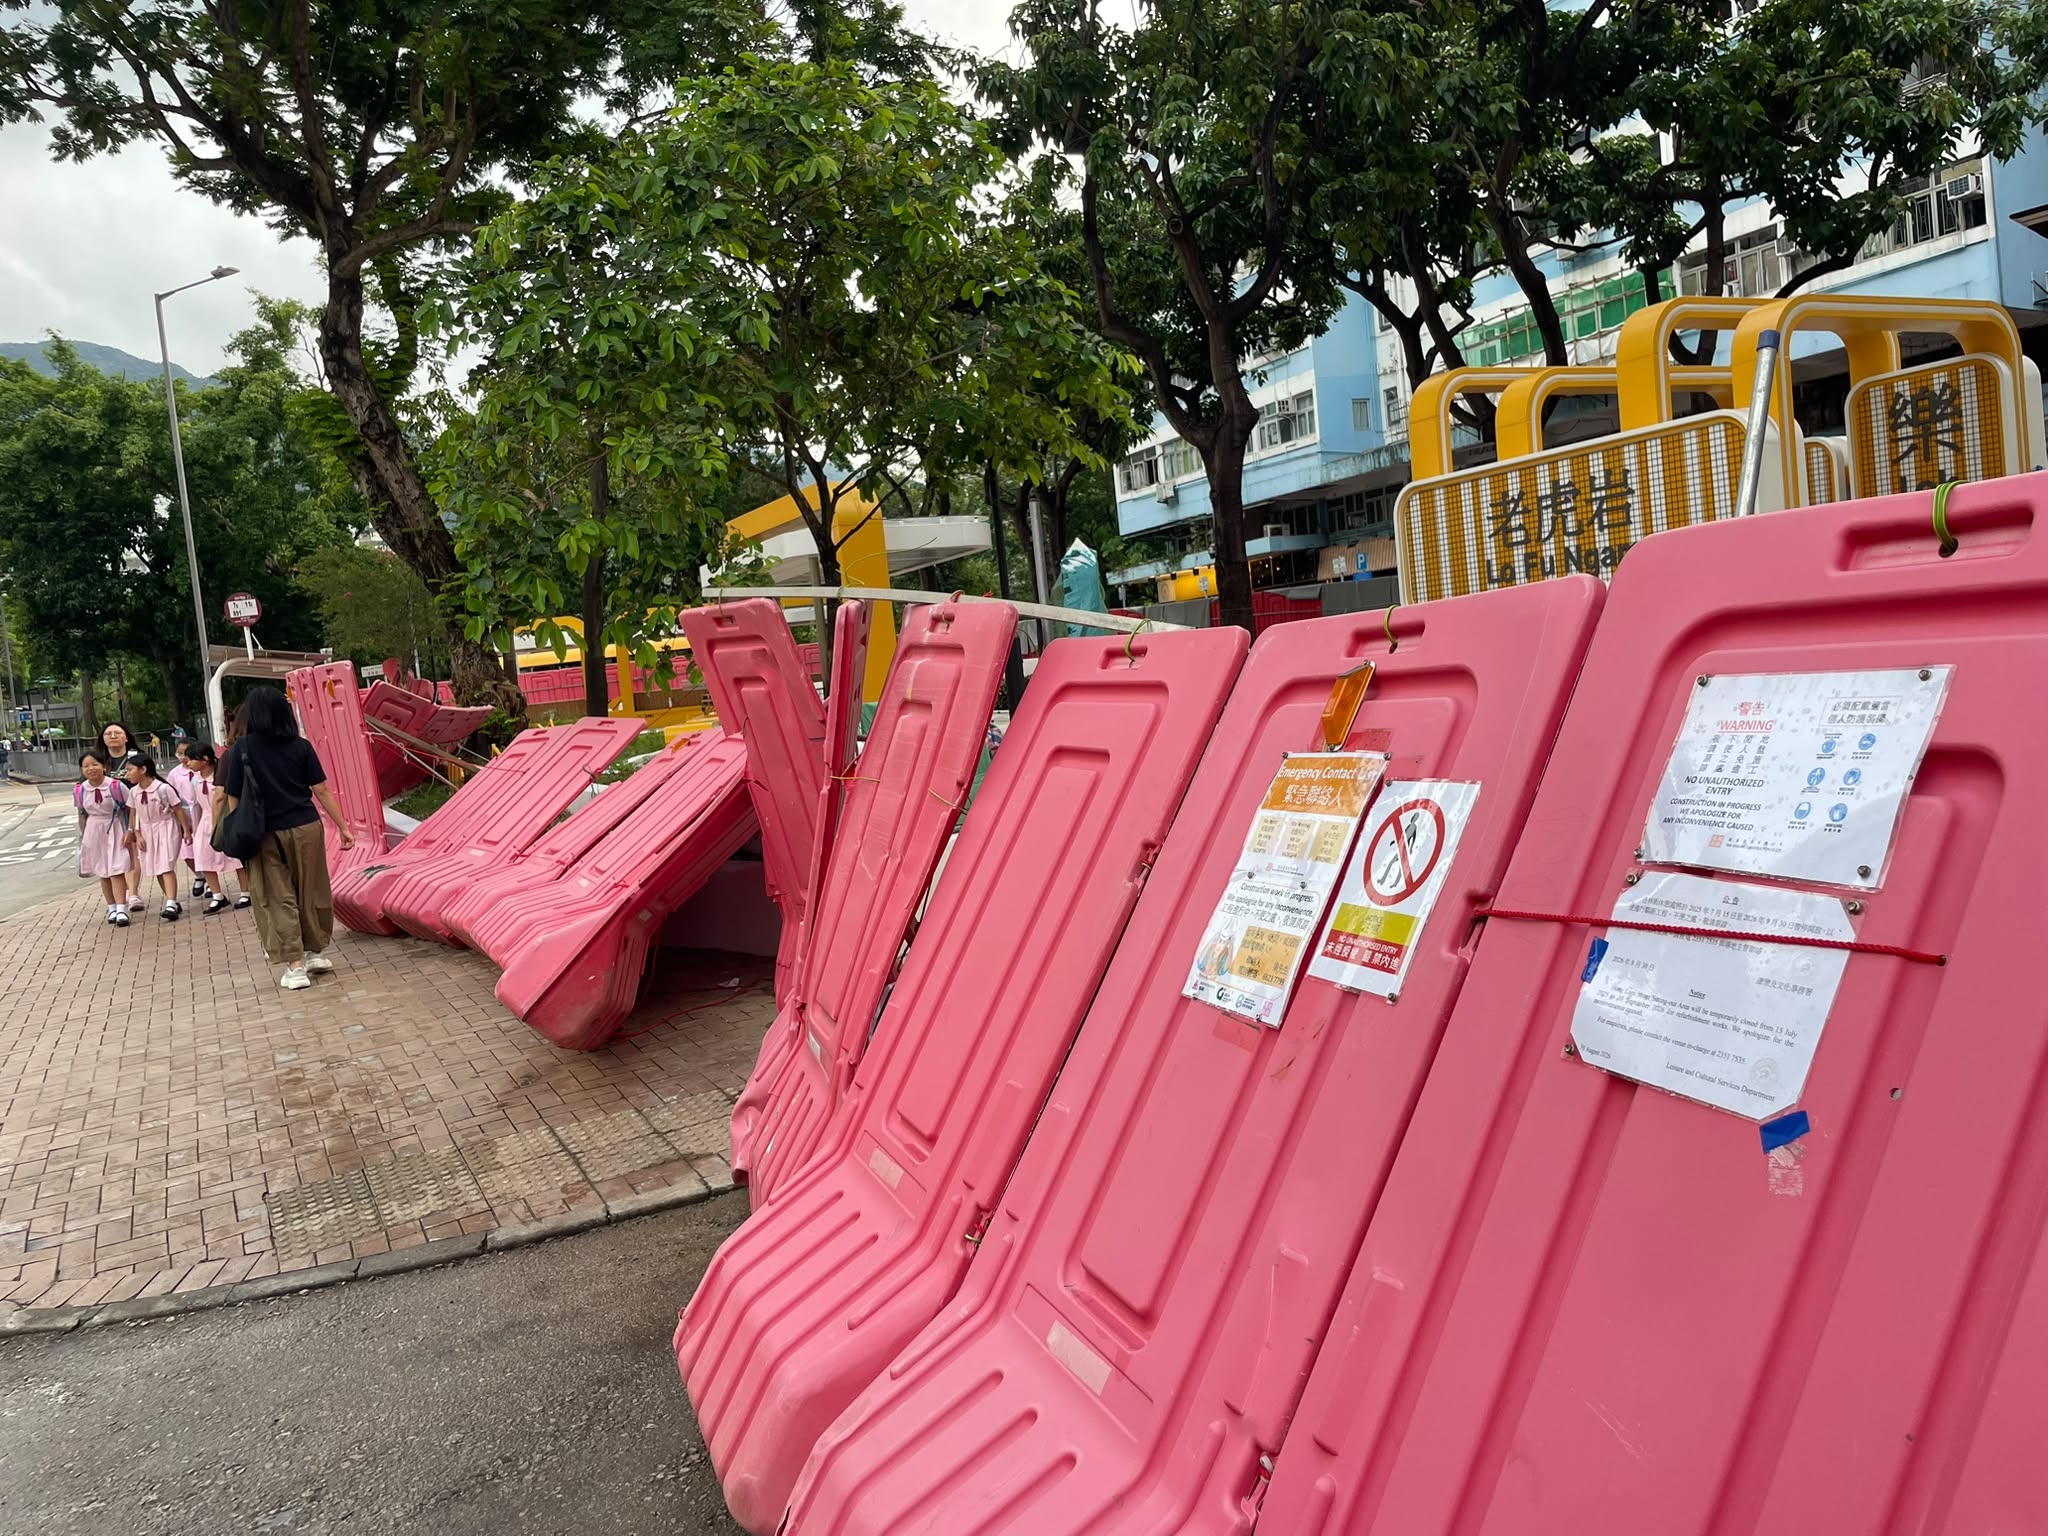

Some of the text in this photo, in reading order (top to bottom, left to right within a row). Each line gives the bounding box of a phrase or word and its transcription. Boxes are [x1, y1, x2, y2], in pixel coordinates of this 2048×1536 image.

[1889, 382, 1964, 463] 樂
[1486, 468, 1635, 548] 老虎岩
[1487, 559, 1516, 584] Lo
[1524, 552, 1556, 578] Fu
[1736, 701, 1766, 715] 警告
[1719, 720, 1774, 730] WARNING
[1278, 766, 1322, 779] Emergency
[1321, 767, 1357, 778] Contact
[1697, 776, 1764, 787] UNAUTHORIZED
[1704, 786, 1733, 795] ENTRY
[1669, 797, 1717, 807] CONSTRUCTION
[1726, 801, 1762, 810] PROGRESS
[1689, 808, 1726, 817] APOLOGIZE
[1674, 817, 1726, 828] INCONVENIENCE
[1725, 821, 1754, 830] CAUSED
[1241, 883, 1270, 893] Construction
[1722, 895, 1740, 905] 公告
[1380, 945, 1397, 954] ENTRY
[1688, 988, 1706, 998] Notice
[1708, 1010, 1739, 1024] temporarily
[1739, 1017, 1758, 1027] closed
[1758, 1022, 1774, 1032] from
[1783, 1029, 1798, 1039] July
[1627, 1024, 1644, 1035] please
[1643, 1029, 1662, 1041] contact
[1686, 1042, 1710, 1055] in-charge
[1715, 1050, 1730, 1061] 2351
[1665, 1061, 1685, 1074] Leisure
[1694, 1070, 1717, 1084] Cultural
[1716, 1077, 1740, 1092] Services
[1740, 1085, 1775, 1103] Department
